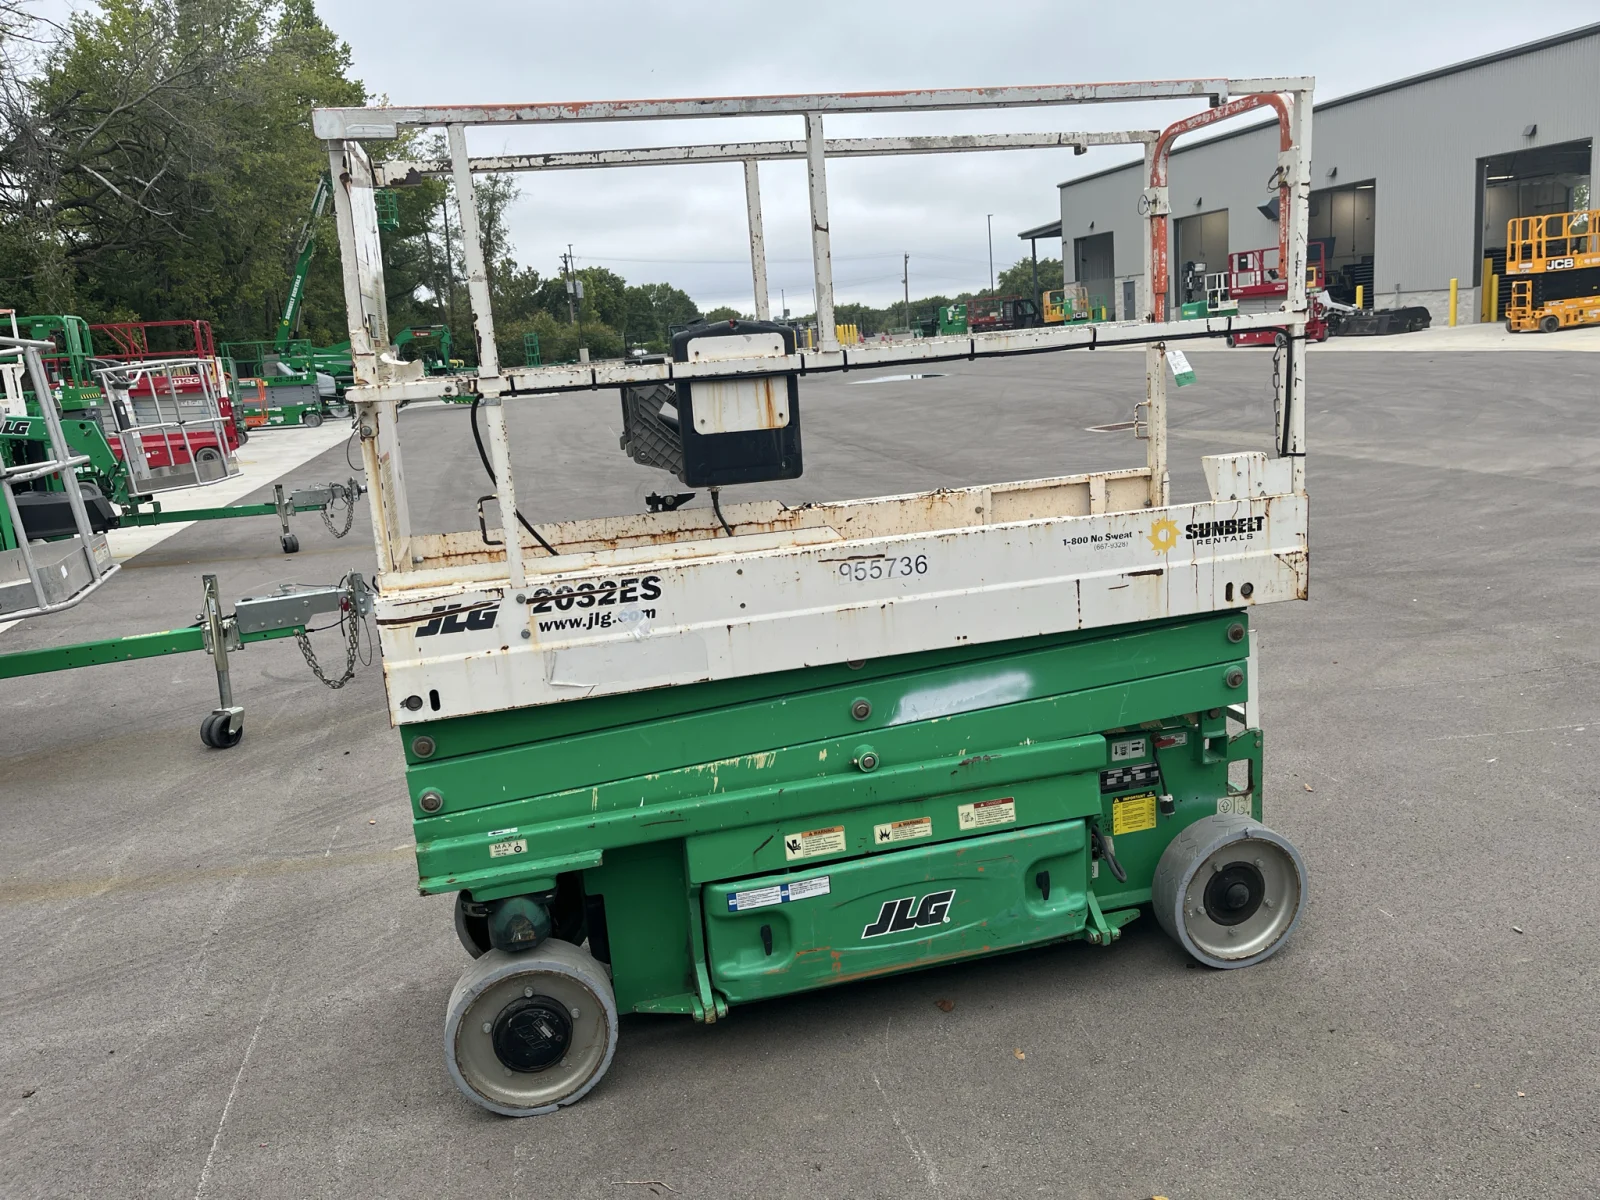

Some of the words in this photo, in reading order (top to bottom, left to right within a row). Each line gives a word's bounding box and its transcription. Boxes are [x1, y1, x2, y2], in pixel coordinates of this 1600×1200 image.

[1546, 258, 1574, 270] JCB
[0, 421, 31, 435] LG
[1185, 516, 1265, 540] SUNBELT
[1062, 536, 1089, 546] 1-800
[1091, 534, 1103, 543] No
[1105, 531, 1133, 541] Sweat
[1196, 533, 1254, 546] RENTALS
[839, 554, 928, 582] 955736
[532, 575, 662, 614] 2032ES
[414, 599, 501, 638] JLG
[903, 818, 924, 826] WARNING
[813, 827, 835, 836] WARNING
[494, 842, 512, 850] MAX
[861, 889, 956, 940] JLG
